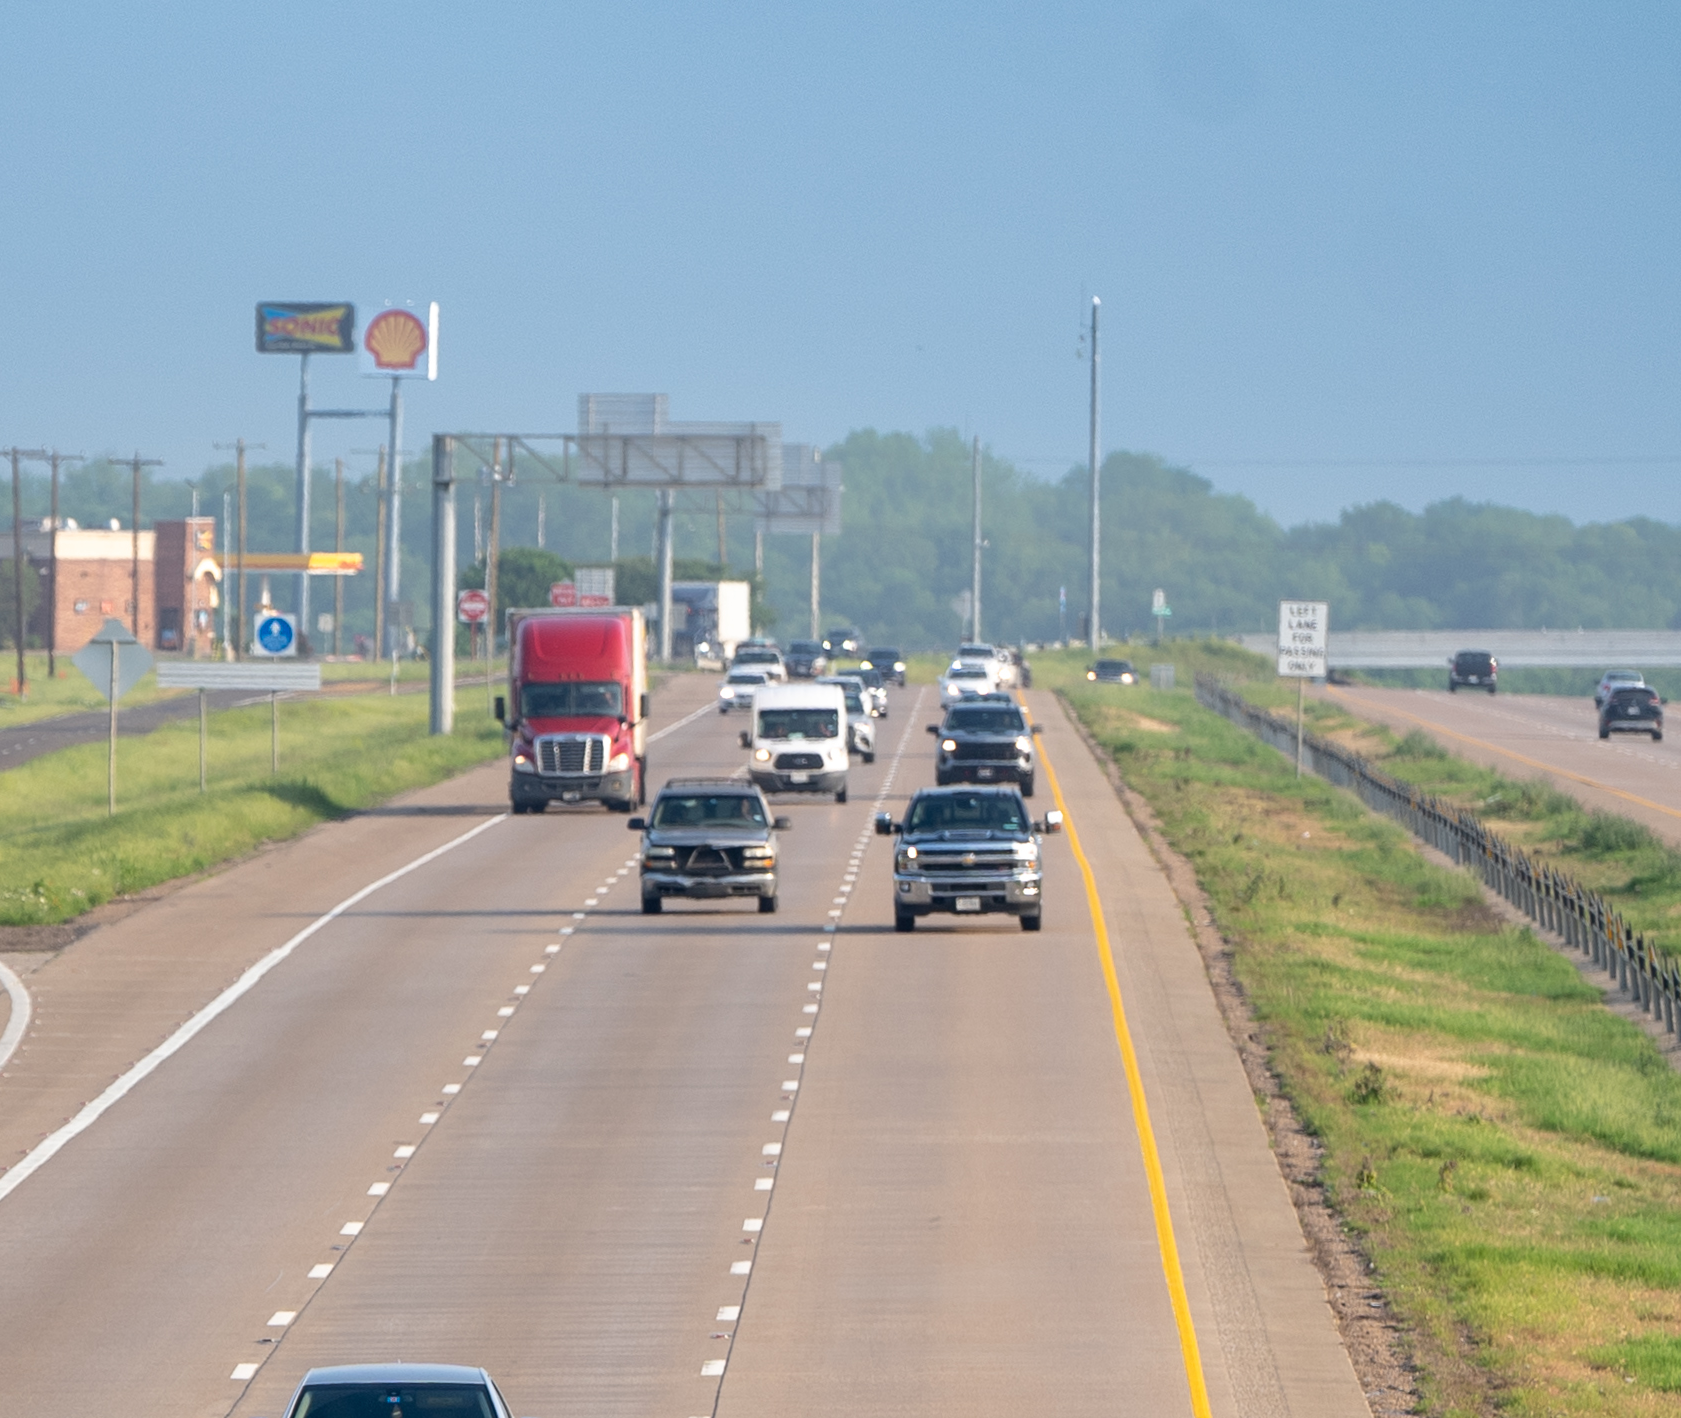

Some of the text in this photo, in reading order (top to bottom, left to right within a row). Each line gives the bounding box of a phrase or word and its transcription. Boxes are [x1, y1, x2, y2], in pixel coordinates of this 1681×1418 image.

[1289, 605, 1317, 617] LEFT
[1288, 619, 1318, 631] LANE
[1292, 632, 1313, 643] FOR
[1279, 645, 1325, 657] PASSING
[1287, 660, 1316, 672] ONLY
